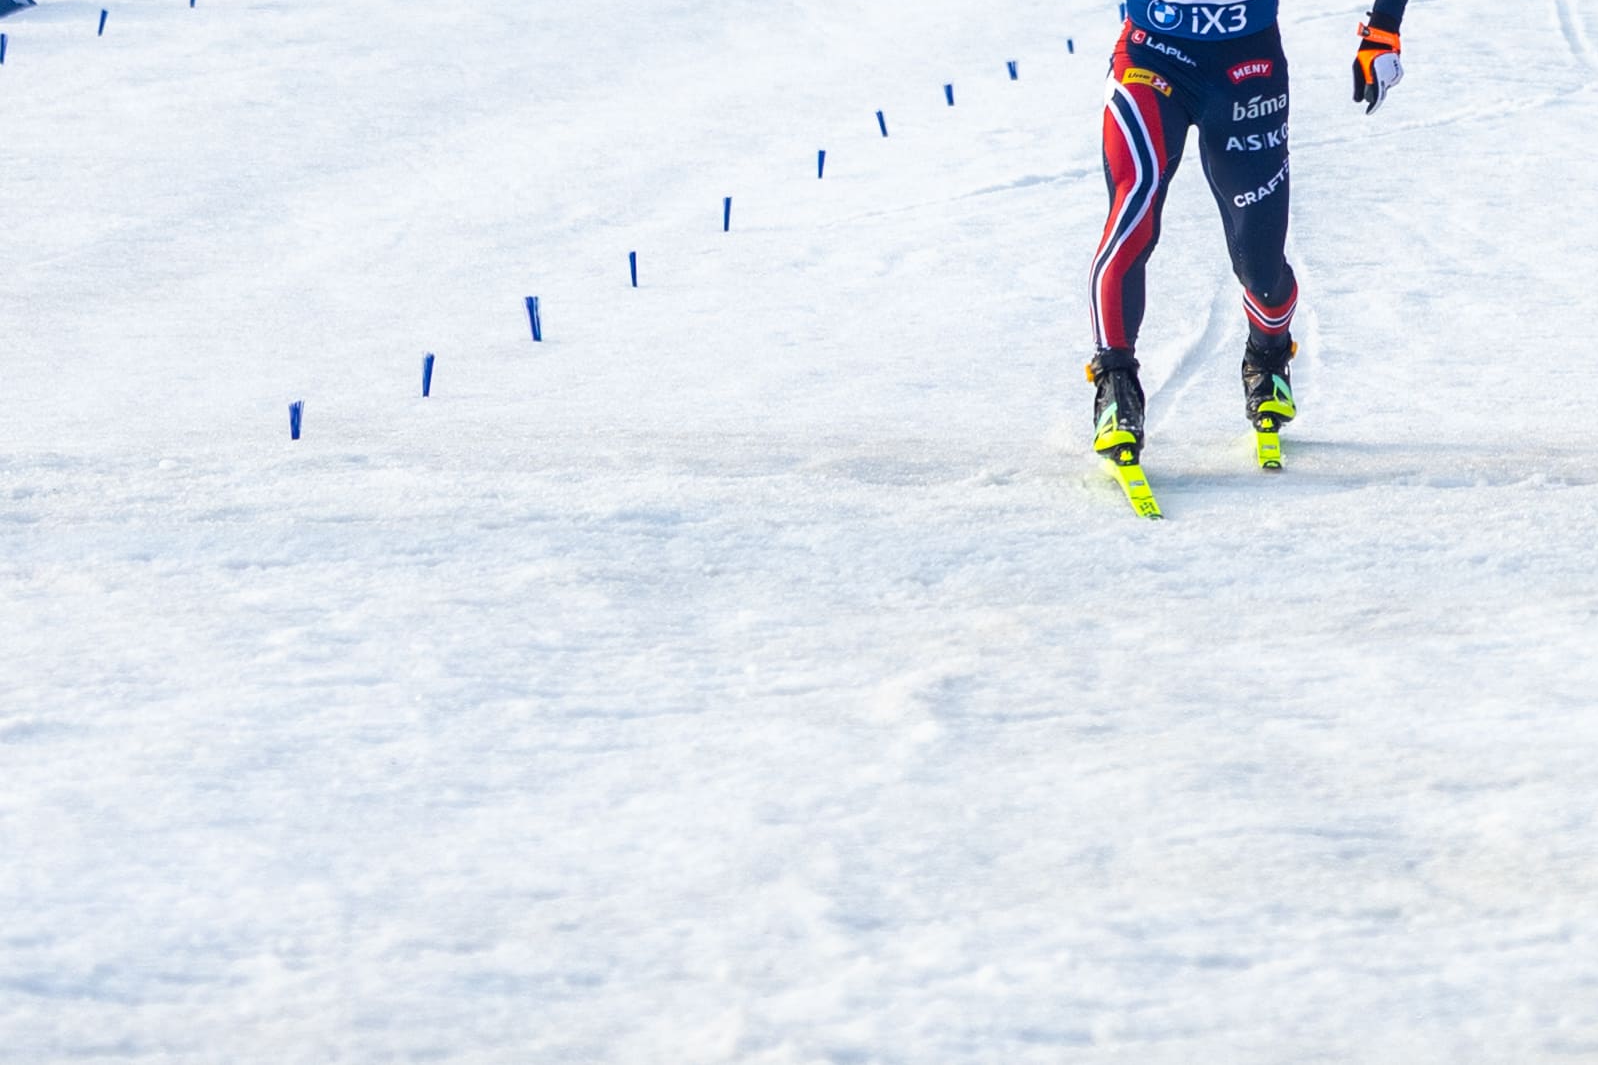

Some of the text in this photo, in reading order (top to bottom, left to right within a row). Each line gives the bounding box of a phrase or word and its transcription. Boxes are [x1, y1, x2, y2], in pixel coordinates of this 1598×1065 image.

[1191, 4, 1248, 35] iX3
[1231, 63, 1270, 80] MENY
[1233, 167, 1285, 208] CRAFT
